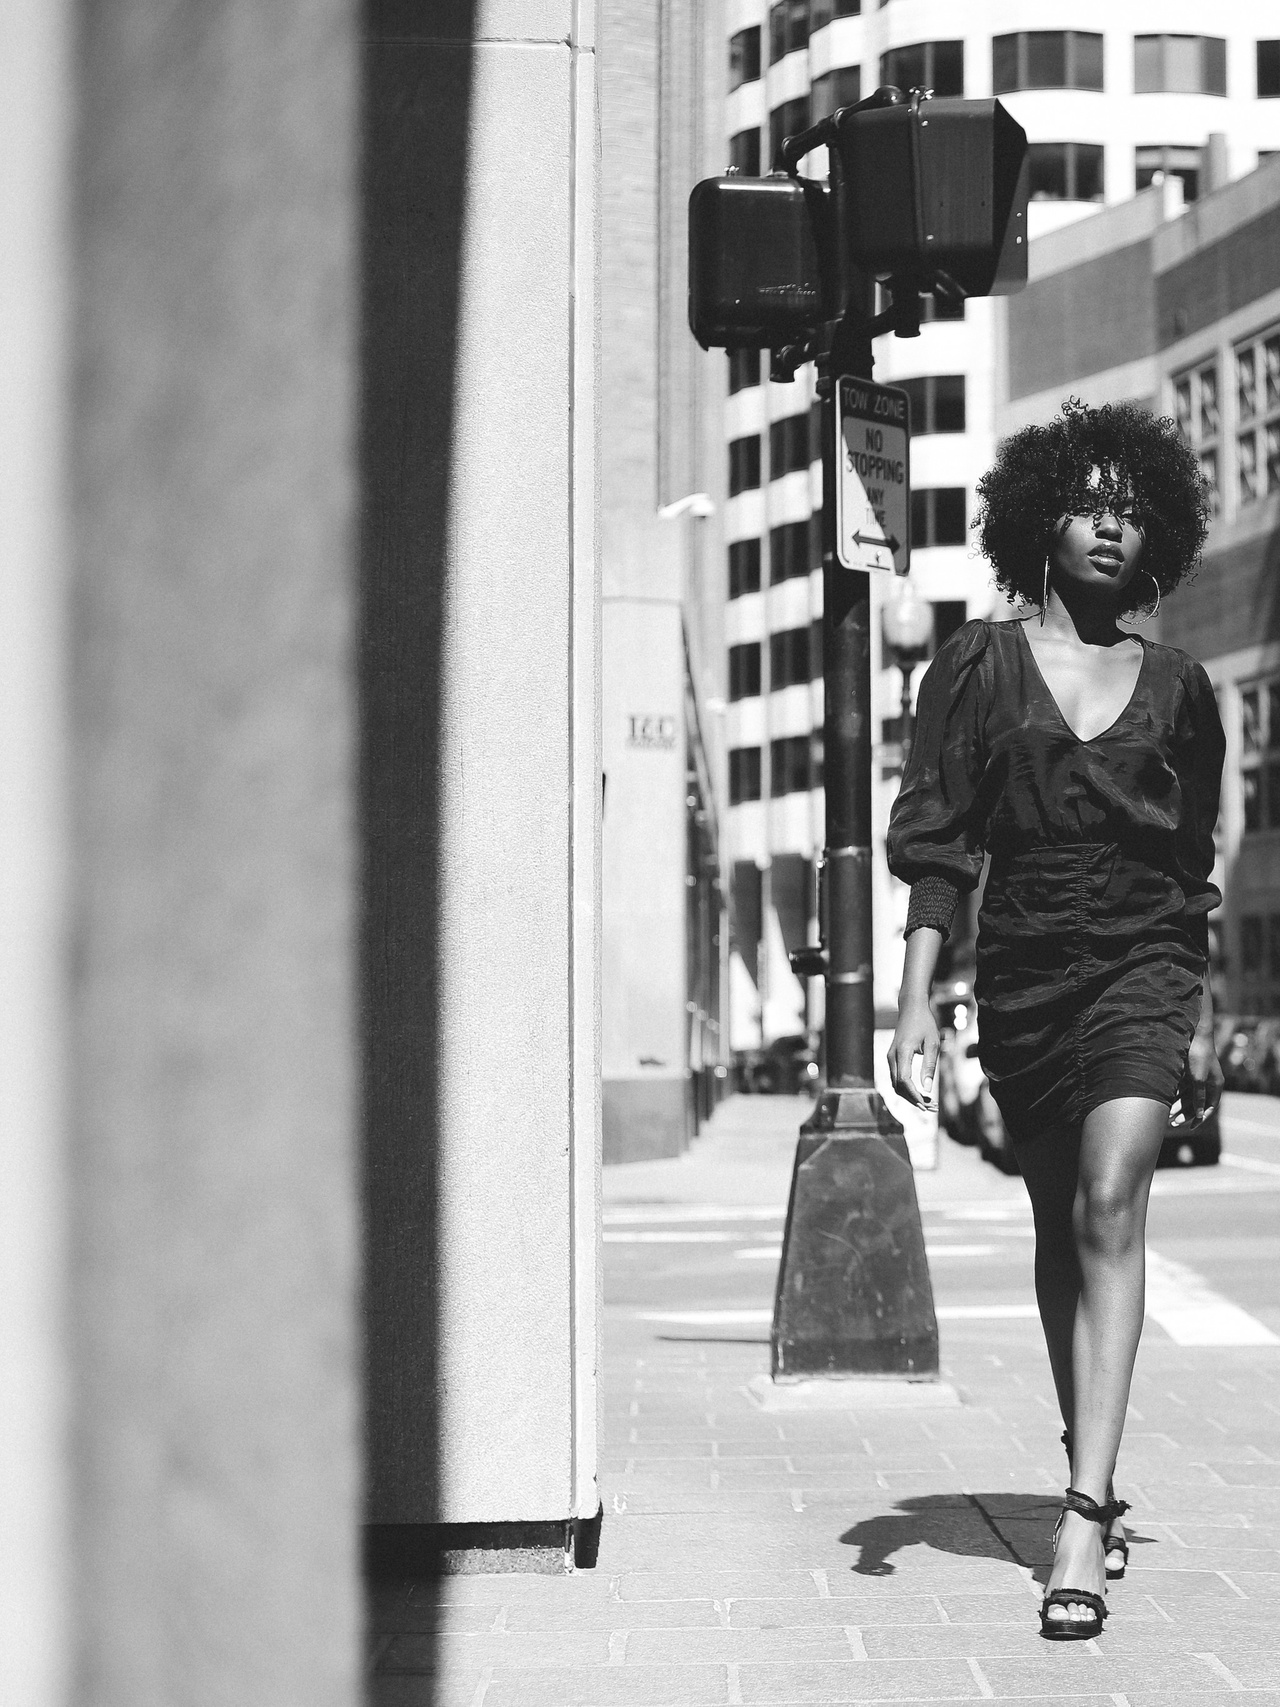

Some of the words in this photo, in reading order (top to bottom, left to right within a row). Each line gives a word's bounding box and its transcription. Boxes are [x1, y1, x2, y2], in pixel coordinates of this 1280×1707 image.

[843, 387, 868, 410] TOW
[874, 394, 904, 419] ZONE
[865, 428, 883, 453] NO
[846, 450, 904, 485] STOPPING
[867, 487, 884, 506] ANY
